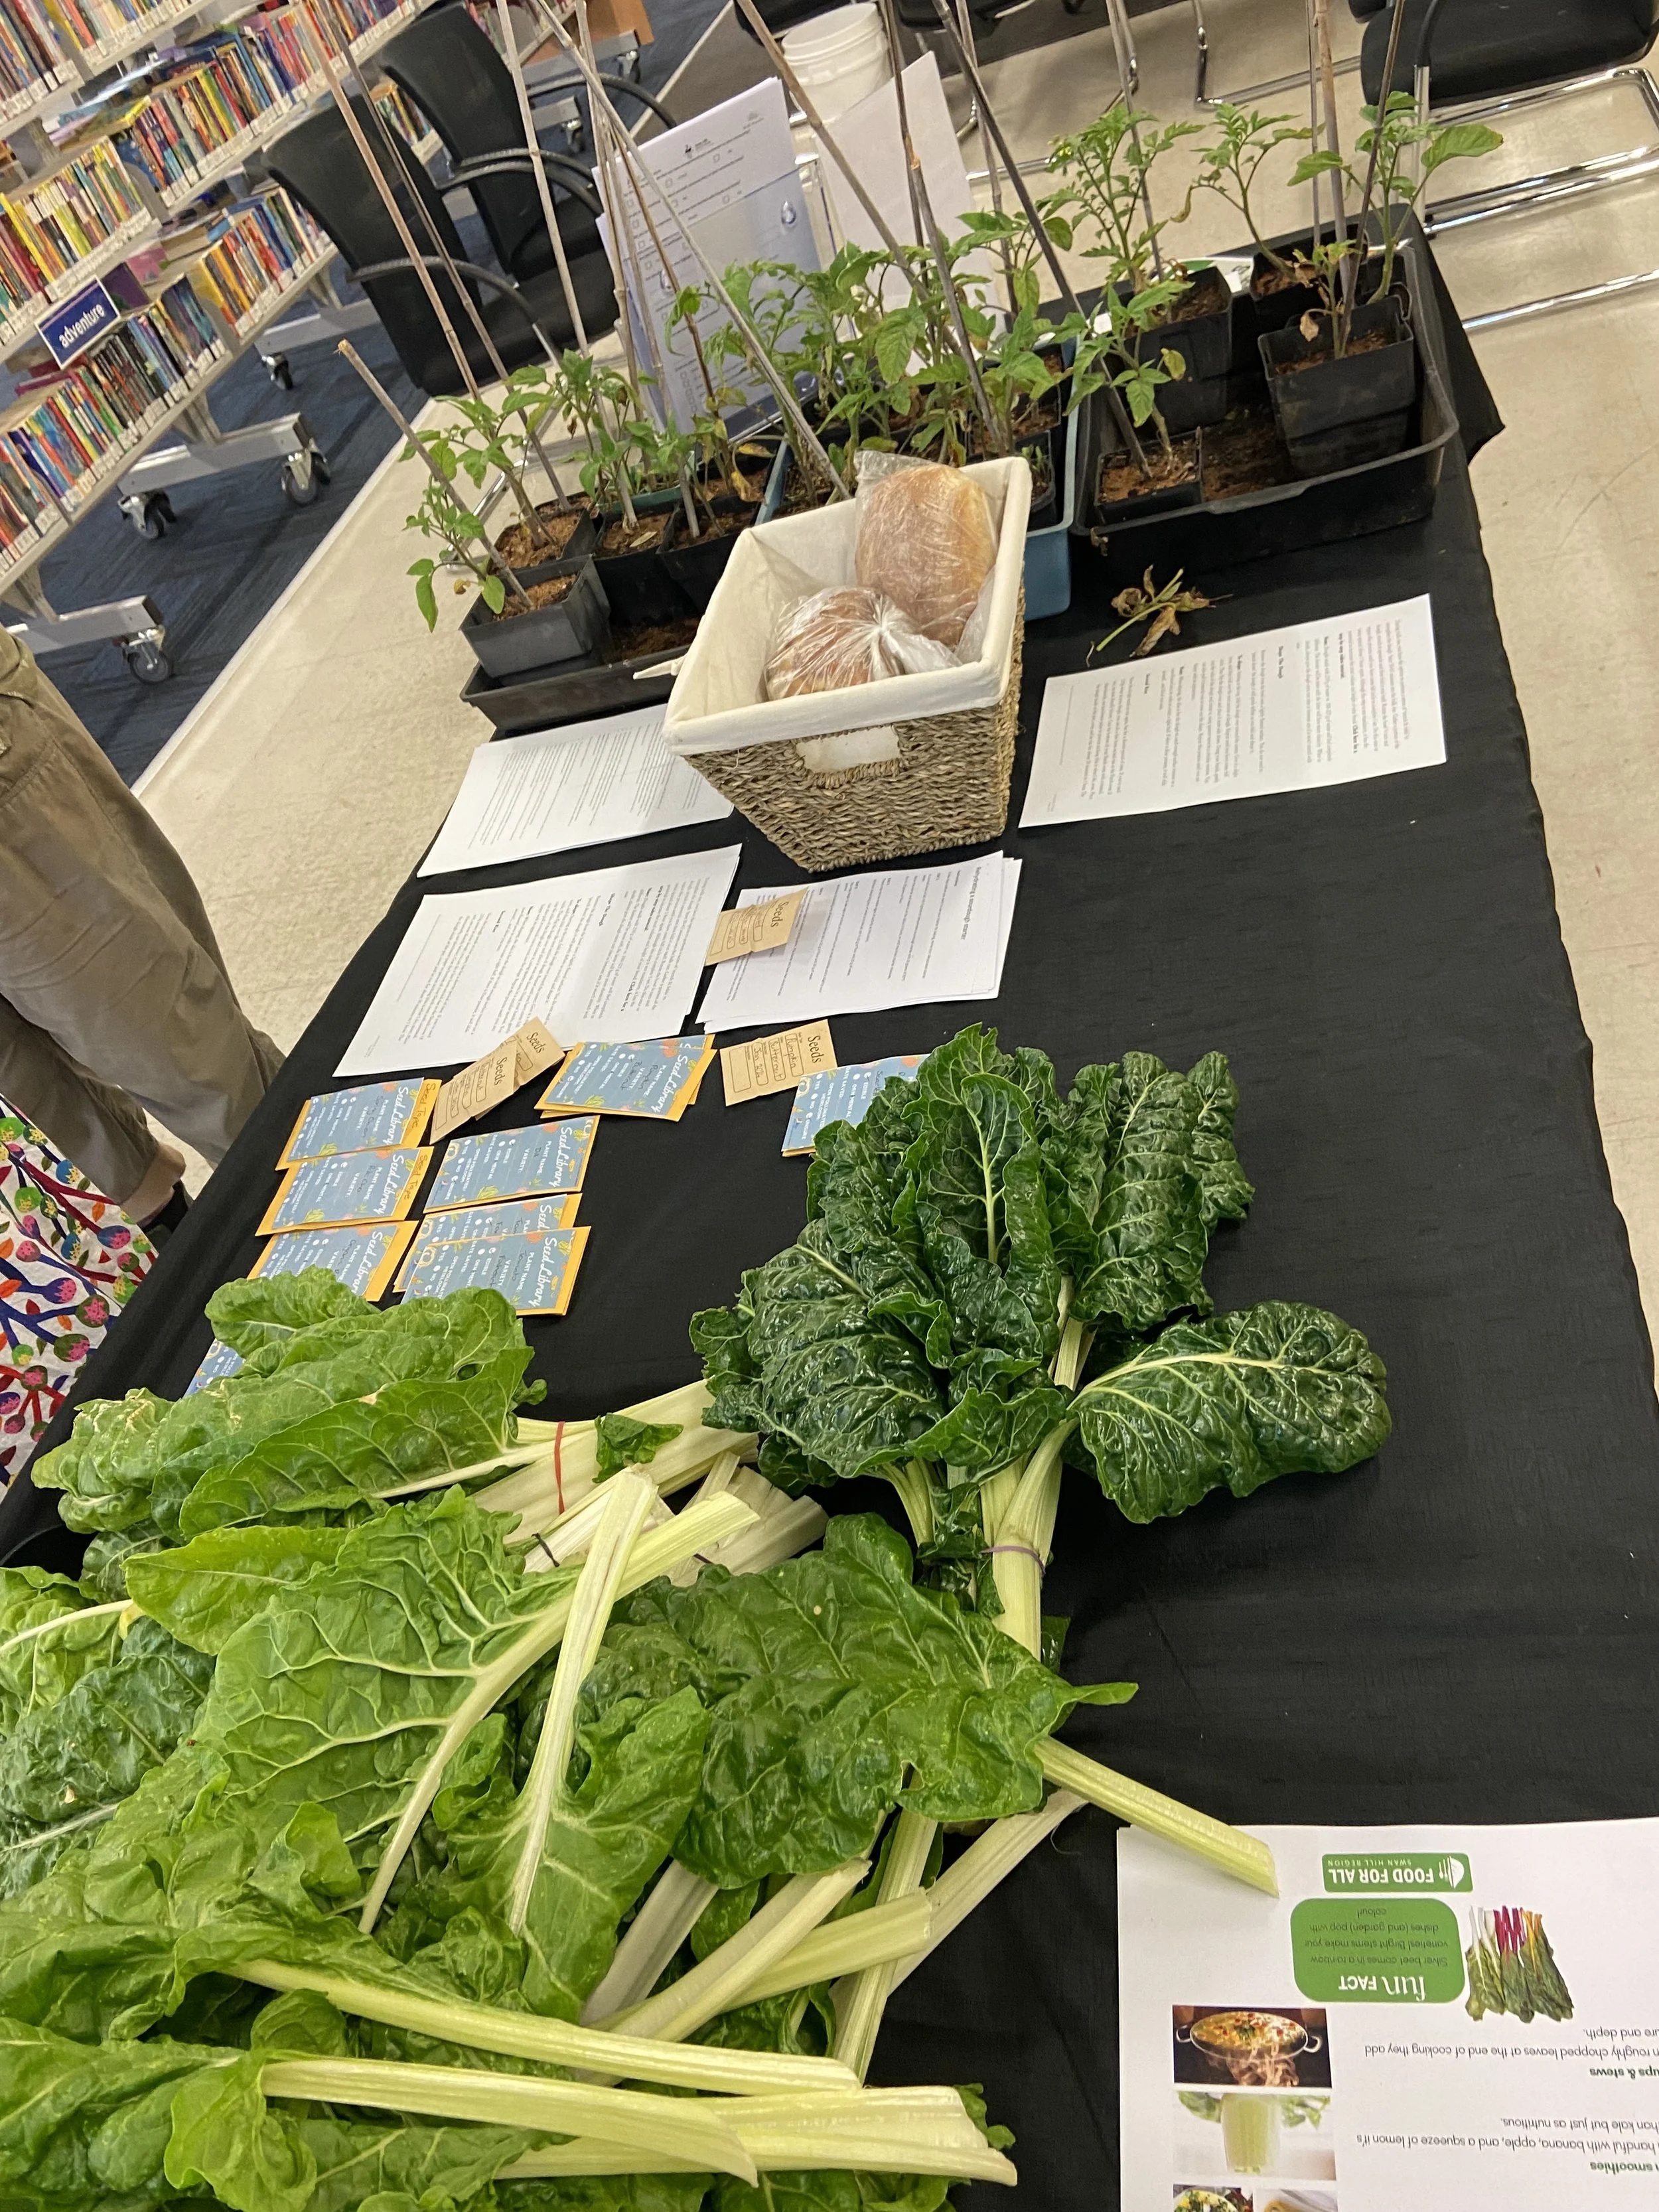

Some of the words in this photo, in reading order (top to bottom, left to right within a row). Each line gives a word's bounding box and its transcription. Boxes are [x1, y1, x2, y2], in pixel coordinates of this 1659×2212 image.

[58, 304, 105, 348] adventure
[770, 901, 789, 927] Seeds
[526, 1033, 545, 1053] Seeds
[808, 1035, 825, 1064] Seeds
[494, 1057, 507, 1086] Seeds
[672, 1055, 688, 1078] Seed
[396, 1086, 409, 1109] Seed
[419, 1083, 436, 1104] Seed
[651, 1076, 677, 1113] Library
[810, 1100, 815, 1109] NO
[846, 1084, 857, 1118] ORNMENTAL
[412, 1108, 426, 1128] Tape
[383, 1108, 404, 1145] Library
[557, 1127, 572, 1152] Seed
[543, 1141, 552, 1157] PLANT
[388, 1154, 404, 1179] Seed
[411, 1154, 427, 1178] Seed
[549, 1151, 569, 1187] Library
[374, 1177, 397, 1215] Library
[403, 1180, 419, 1201] Tape
[538, 1205, 551, 1232] Seed
[368, 1231, 382, 1256] Seed
[541, 1237, 557, 1267] Seed
[326, 1250, 340, 1269] VARIE
[525, 1252, 535, 1271] PLANT
[351, 1255, 372, 1293] Librar
[481, 1258, 492, 1276] EDIBLE
[528, 1264, 552, 1307] Library
[1327, 1868, 1354, 1883] ALL
[1358, 1868, 1388, 1882] FOR
[1392, 1868, 1434, 1882] FOOD
[1356, 1907, 1386, 1917] colour!
[1309, 1923, 1327, 1933] with
[1329, 1921, 1347, 1931] pop
[1349, 1921, 1384, 1933] garden)
[1388, 1922, 1408, 1933] (and
[1409, 1923, 1438, 1933] dishes
[1304, 1938, 1324, 1947] your
[1325, 1939, 1348, 1949] make
[1350, 1939, 1377, 1949] stems
[1310, 1955, 1346, 1964] rainbow
[1357, 1956, 1364, 1966] in
[1367, 1956, 1397, 1964] comes
[1400, 1956, 1421, 1966] beet
[1423, 1956, 1448, 1967] Silver
[1338, 1975, 1377, 1990] FACT
[1381, 1976, 1425, 2002] fun
[1583, 2026, 1618, 2040] depth.
[1620, 2028, 1641, 2040] and
[1364, 2045, 1385, 2056] add
[1388, 2042, 1408, 2057] they
[1411, 2043, 1451, 2057] cooking
[1455, 2047, 1465, 2058] of
[1468, 2046, 1488, 2058] end
[1490, 2047, 1507, 2058] the
[1510, 2047, 1521, 2057] at
[1523, 2047, 1557, 2060] leaves
[1559, 2044, 1609, 2060] chopped
[1611, 2045, 1650, 2060] roughly
[1589, 2068, 1624, 2078] stews
[1626, 2068, 1636, 2079] &
[1638, 2065, 1659, 2077] ups
[1500, 2118, 1551, 2130] nutritious.
[1553, 2119, 1566, 2128] as
[1569, 2117, 1587, 2130] just
[1591, 2120, 1609, 2133] but
[1611, 2120, 1634, 2134] kale
[1636, 2120, 1659, 2132] han
[1372, 2135, 1405, 2148] lemon
[1408, 2136, 1417, 2148] of
[1421, 2134, 1465, 2146] squeeze
[1478, 2138, 1499, 2150] and
[1501, 2135, 1536, 2151] apple,
[1538, 2137, 1585, 2153] banana,
[1586, 2140, 1610, 2153] with
[1613, 2141, 1656, 2155] handful
[1589, 2162, 1652, 2174] smoothies
